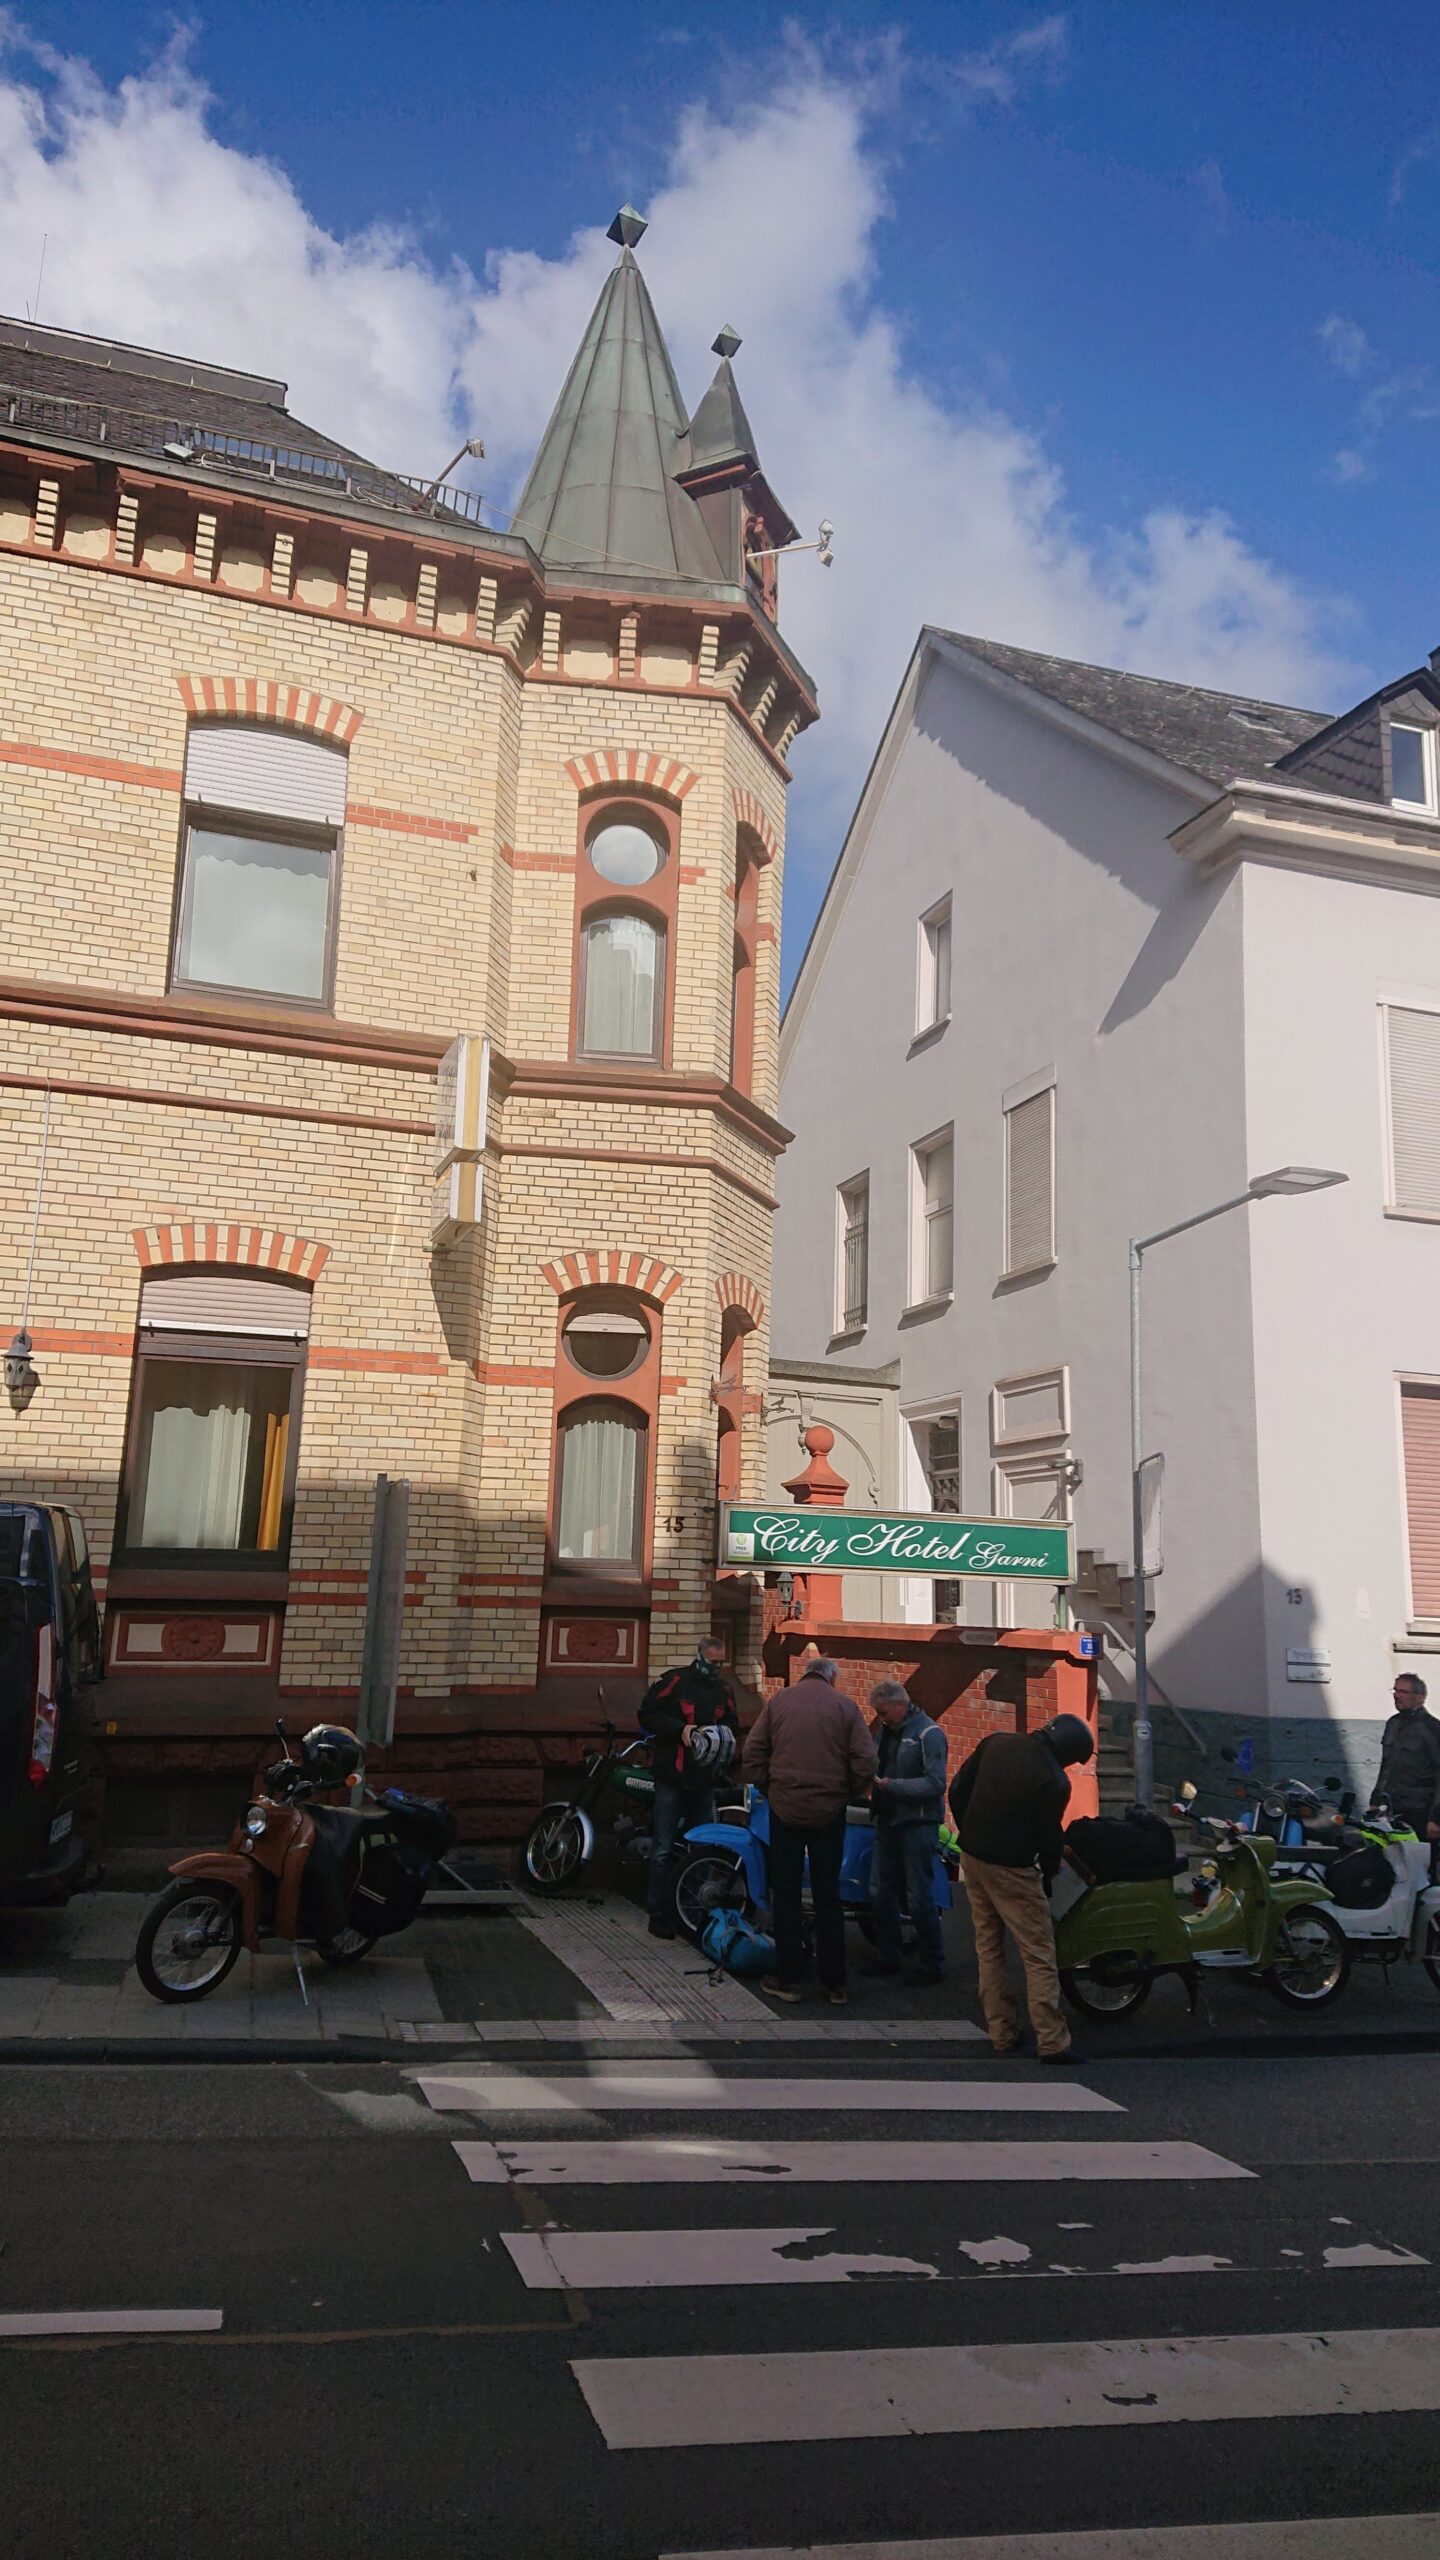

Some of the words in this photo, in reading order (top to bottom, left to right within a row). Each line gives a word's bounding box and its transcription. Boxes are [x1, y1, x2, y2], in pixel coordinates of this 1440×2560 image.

[662, 1515, 685, 1533] 15
[753, 1515, 840, 1564] City
[846, 1523, 971, 1560] Hotel
[968, 1541, 1049, 1569] Garni
